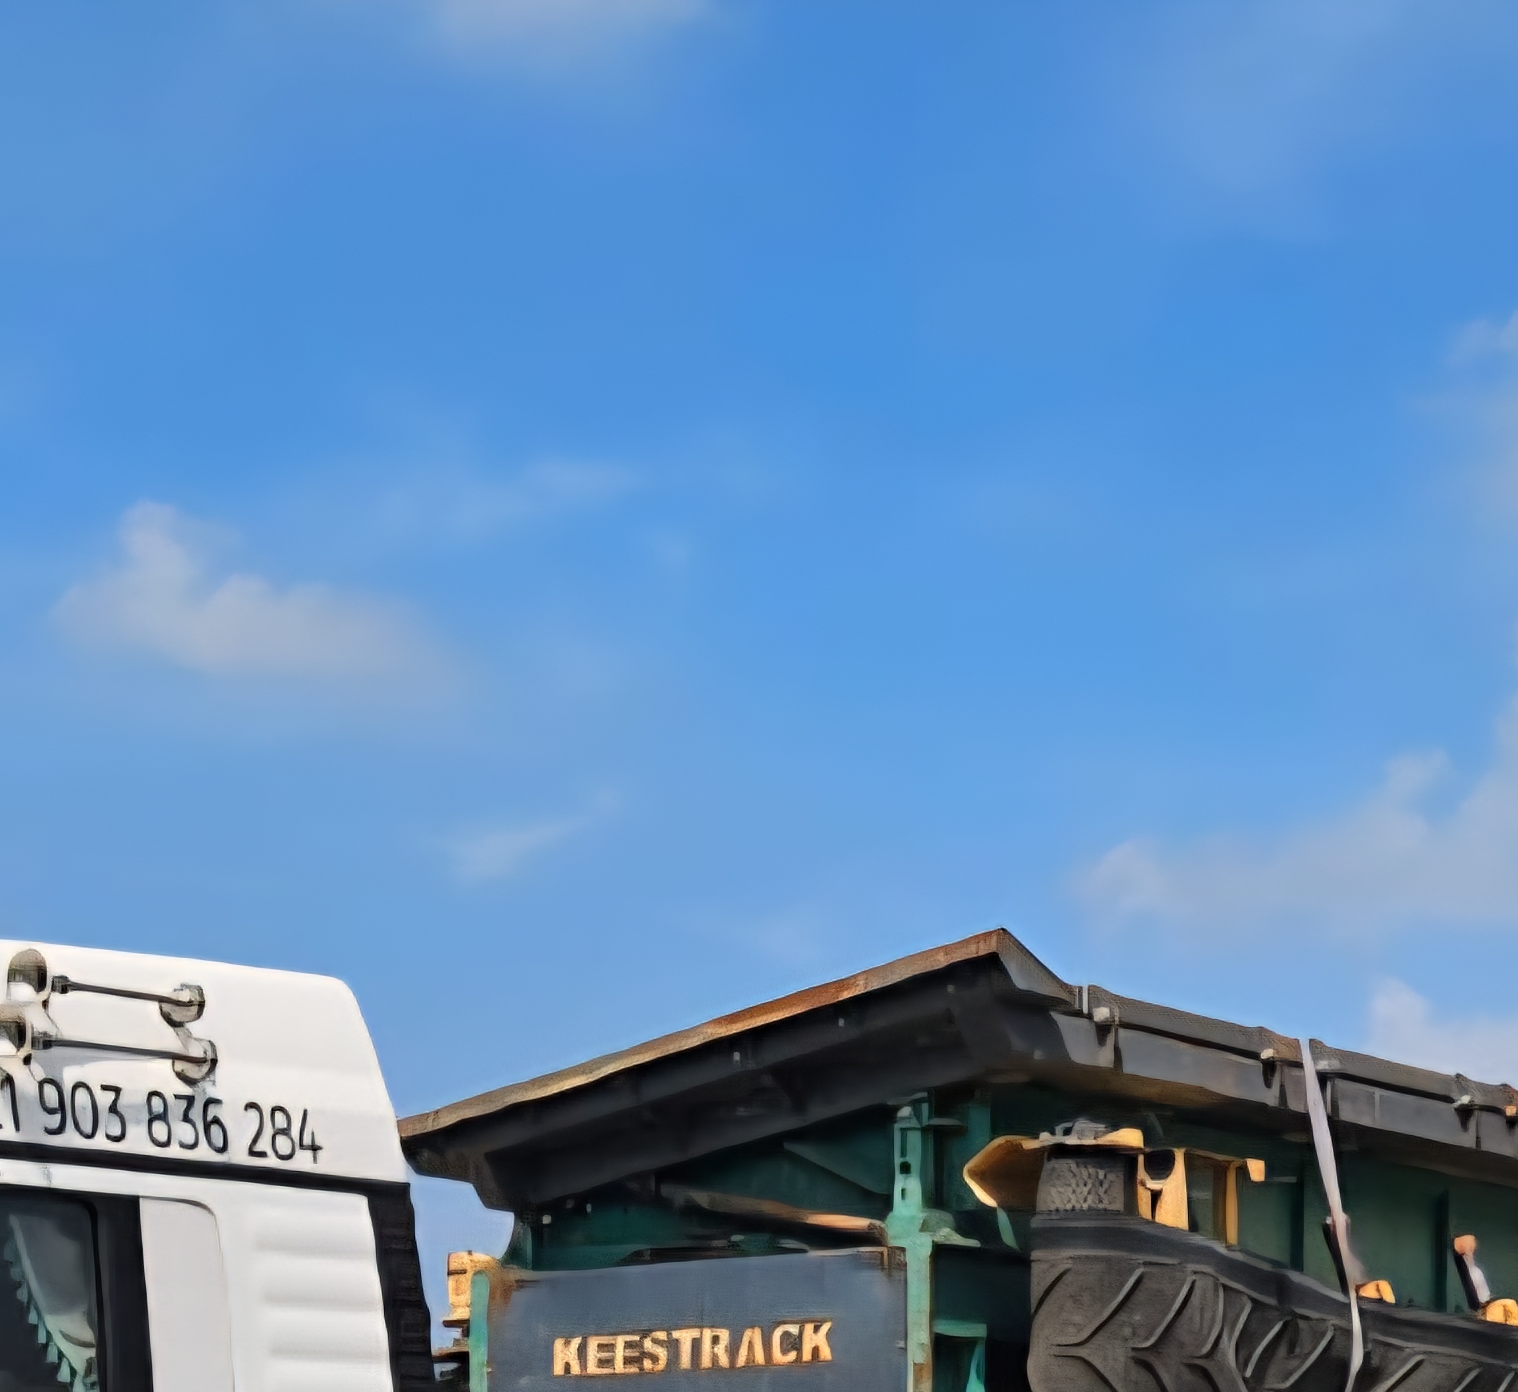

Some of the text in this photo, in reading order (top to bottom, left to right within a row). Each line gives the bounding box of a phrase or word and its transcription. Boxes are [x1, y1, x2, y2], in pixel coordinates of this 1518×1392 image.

[38, 1078, 128, 1144] 903
[146, 1089, 230, 1154] 836
[246, 1101, 324, 1164] 284
[552, 1319, 834, 1377] KEESTRACK
